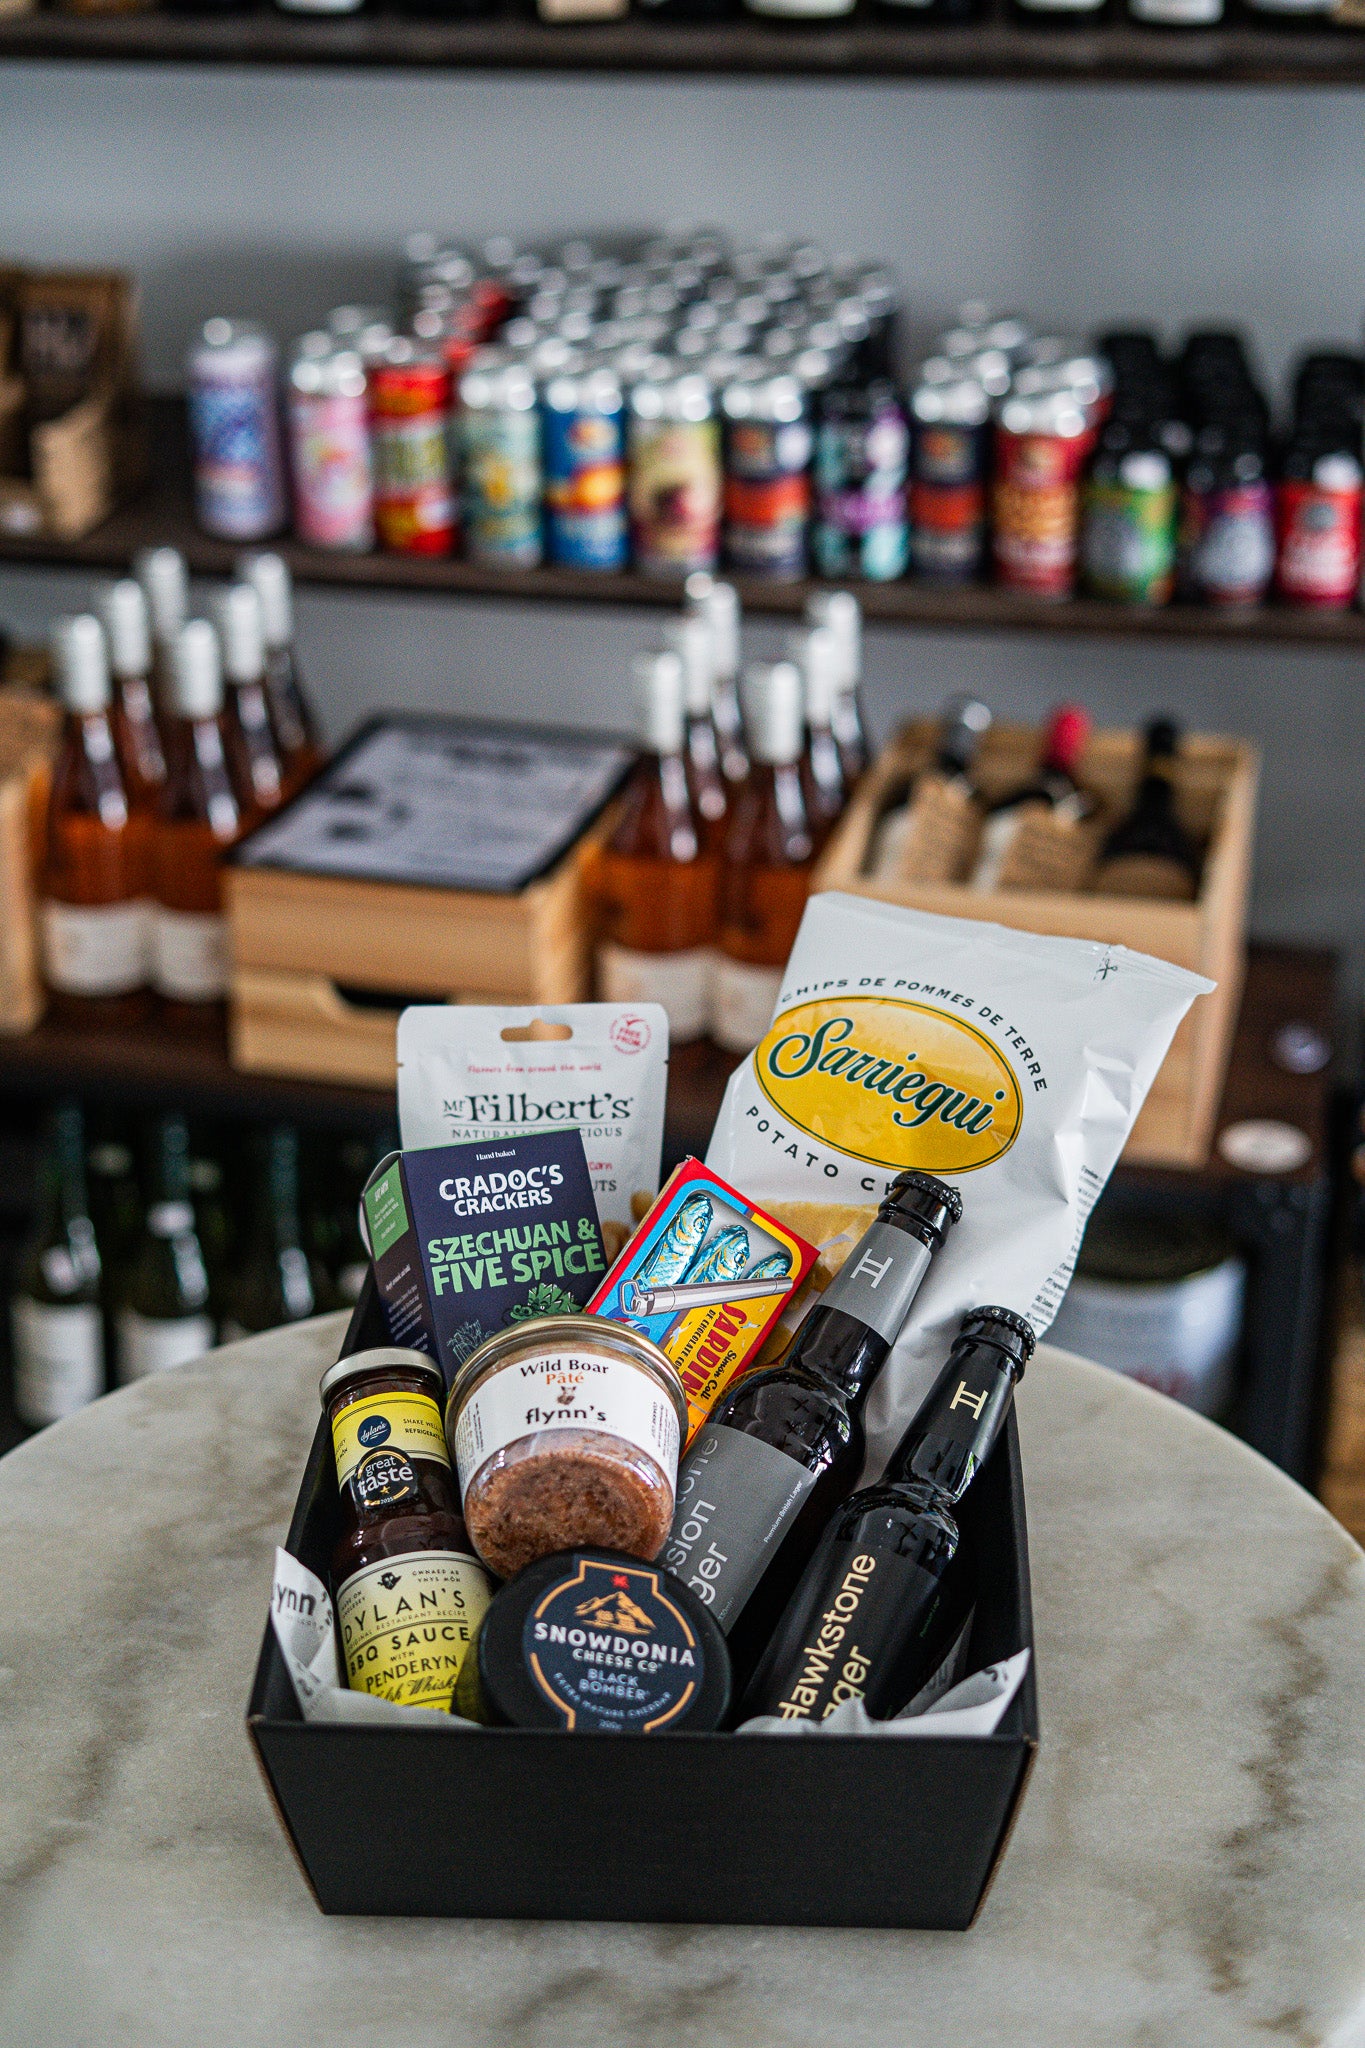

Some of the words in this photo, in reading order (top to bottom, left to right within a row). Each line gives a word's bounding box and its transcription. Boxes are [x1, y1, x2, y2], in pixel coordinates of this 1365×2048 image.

[781, 977, 848, 1003] CHIPS
[858, 977, 886, 987] DE
[894, 979, 975, 1008] POMMES
[977, 1006, 1004, 1027] DE
[1004, 1026, 1048, 1092] TERRE
[560, 1063, 575, 1071] the
[767, 1017, 1005, 1135] Sarriegui
[465, 1092, 632, 1123] Filbert's
[452, 1127, 537, 1139] NATURAL
[746, 1105, 839, 1178] POTATO
[475, 1150, 495, 1160] Hand
[495, 1148, 516, 1159] baked
[438, 1164, 564, 1201] CRADOC'S
[453, 1187, 553, 1217] CRACKERS
[427, 1220, 572, 1264] SZECHUAN
[577, 1218, 598, 1240] &
[431, 1256, 508, 1296] FIVE
[511, 1242, 606, 1283] SPICE
[705, 1309, 716, 1320] DE
[680, 1320, 710, 1358] CHOCOLATE
[520, 1359, 561, 1377] Wild
[569, 1359, 609, 1375] Boar
[546, 1371, 584, 1385] Pâté
[714, 1349, 737, 1378] Simón
[700, 1379, 718, 1400] Coll
[526, 1405, 606, 1424] flynn's
[360, 1421, 388, 1443] dylan's
[357, 1466, 414, 1496] taste
[365, 1456, 397, 1476] great
[763, 1516, 782, 1543] Premium
[779, 1498, 793, 1517] British
[789, 1480, 802, 1499] Lager
[665, 1500, 716, 1576] sion
[688, 1541, 728, 1605] ger
[276, 1583, 332, 1626] ynn's
[344, 1588, 466, 1644] DYLAN'S
[376, 1611, 432, 1631] RESTAURANT
[350, 1645, 379, 1677] BBQ
[391, 1626, 470, 1650] SAUCE
[533, 1622, 696, 1668] SNOWDONIA
[778, 1554, 877, 1720] Hawkstone
[390, 1651, 415, 1662] WITH
[572, 1648, 633, 1670] CHEESE
[365, 1655, 458, 1693] PENDERYN
[407, 1673, 457, 1696] Whisk
[587, 1668, 639, 1687] BLACK
[822, 1645, 872, 1718] ger
[553, 1672, 581, 1702] EXTRA
[582, 1700, 625, 1718] MATURE
[626, 1691, 672, 1719] CHEDDAR
[579, 1678, 647, 1701] BOMBER
